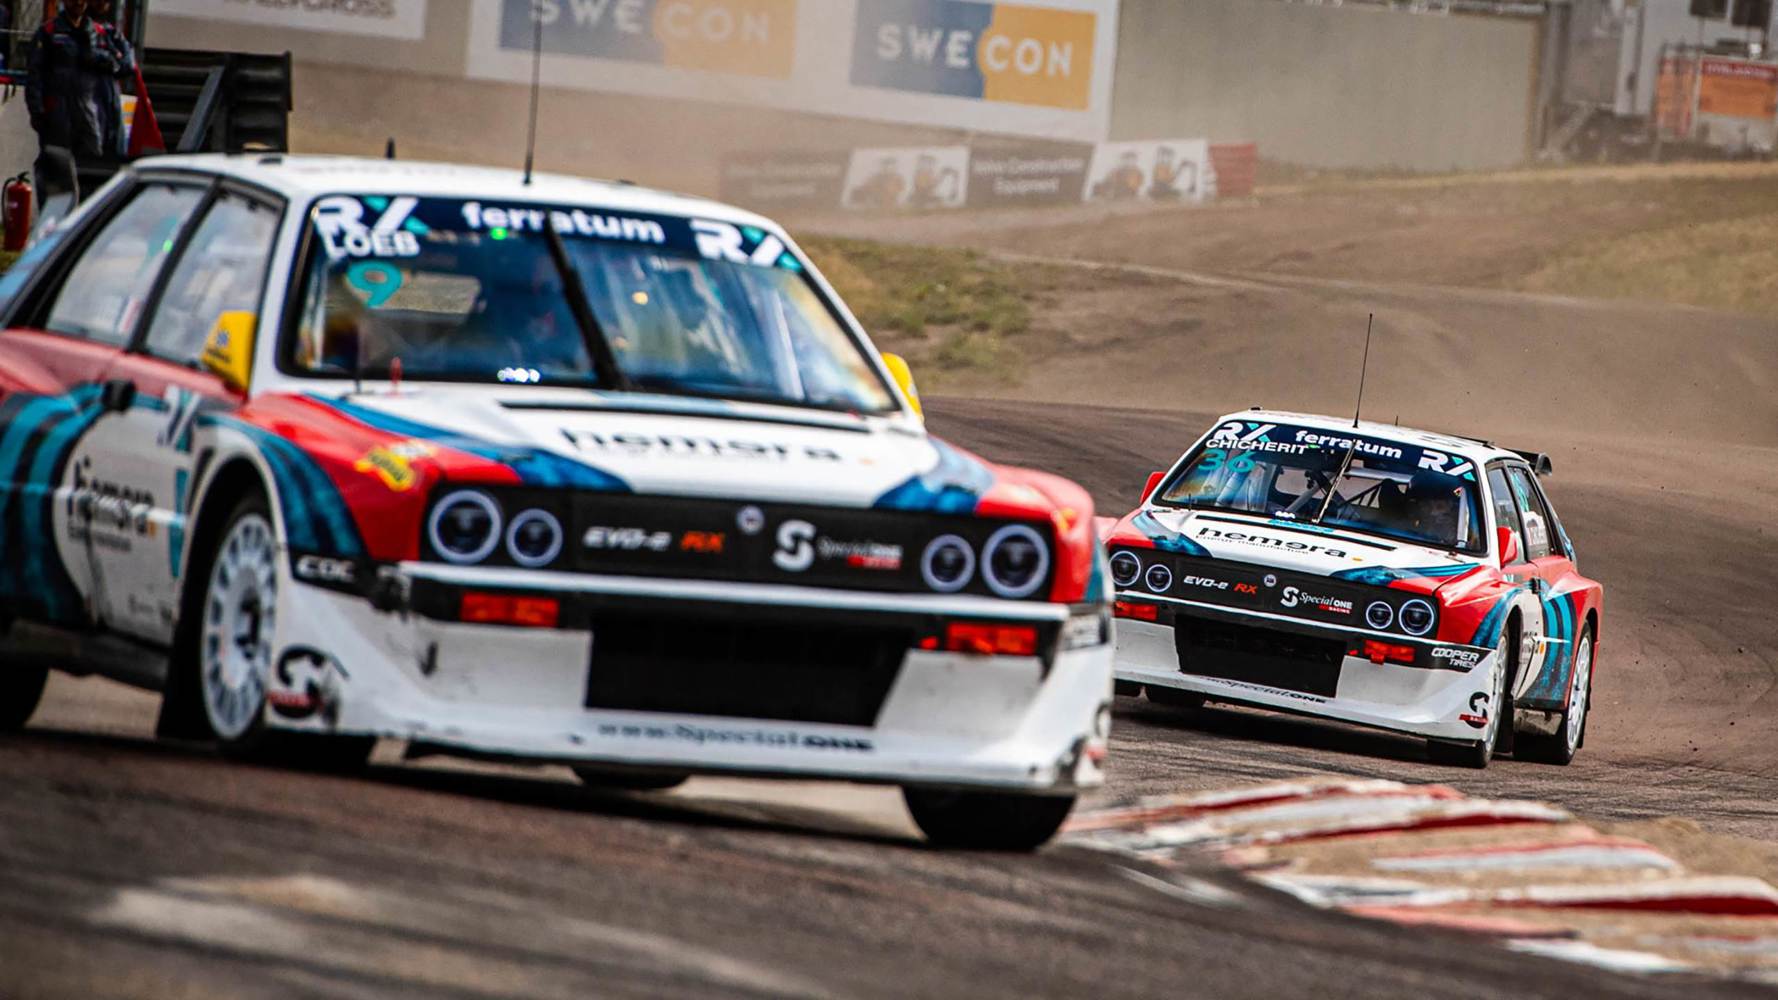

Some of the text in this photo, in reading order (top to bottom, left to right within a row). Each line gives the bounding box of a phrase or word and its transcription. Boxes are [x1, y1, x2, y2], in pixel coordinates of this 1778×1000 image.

[531, 0, 768, 41] SWECON
[878, 24, 1073, 77] SWECON
[462, 202, 666, 243] ferratum
[323, 230, 420, 258] LOEB
[347, 261, 403, 308] 9
[1213, 422, 1278, 442] RX
[1295, 430, 1403, 459] ferratum
[1205, 438, 1309, 455] CHICHERIT
[1198, 450, 1256, 473] 36
[1418, 450, 1479, 480] RX
[1233, 582, 1259, 595] RX
[1431, 647, 1480, 662] COOPER
[1449, 658, 1477, 669] TIRES
